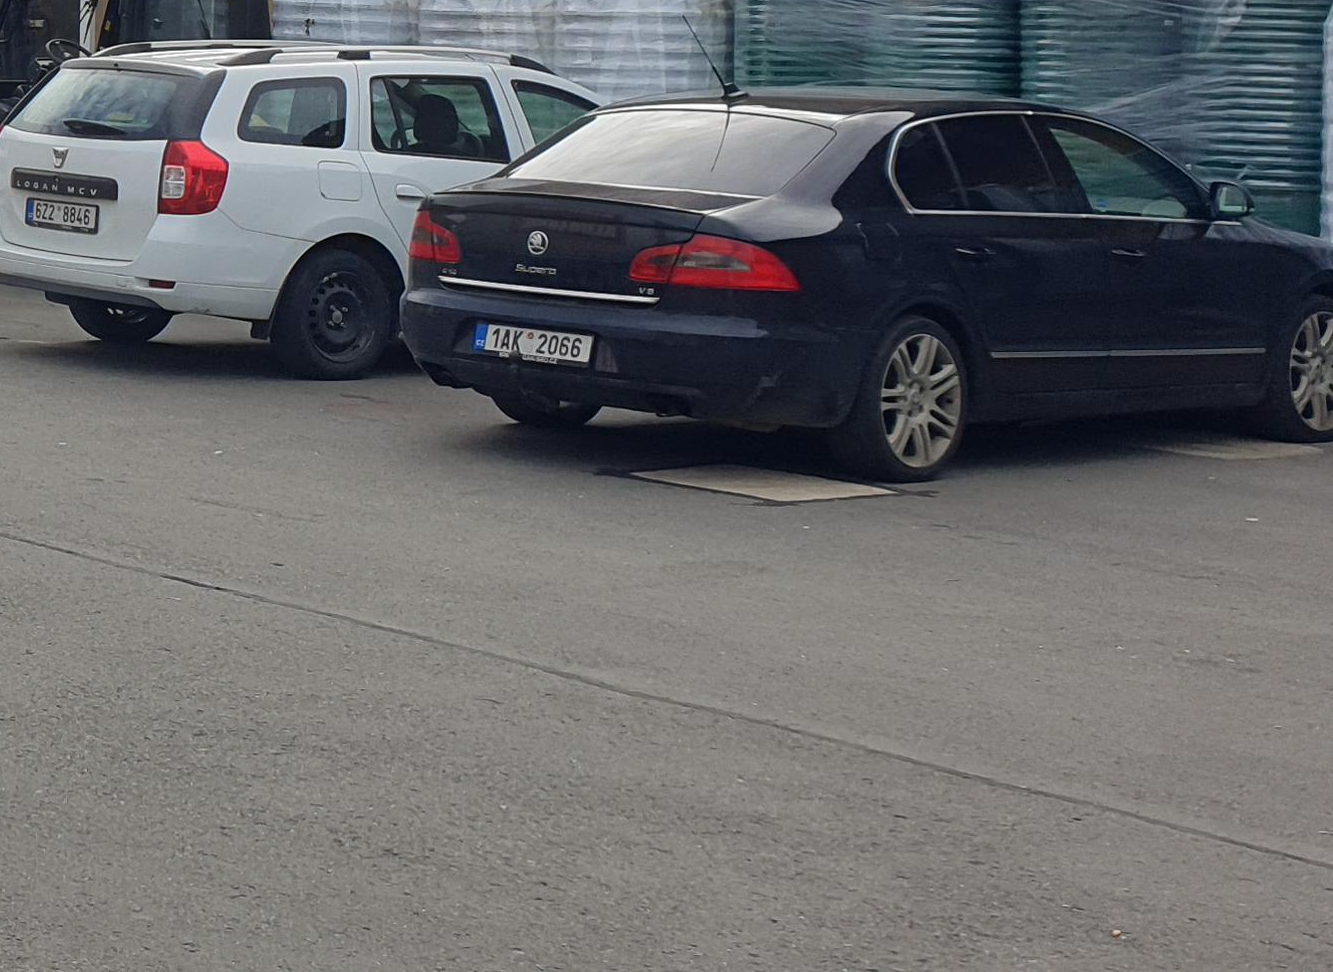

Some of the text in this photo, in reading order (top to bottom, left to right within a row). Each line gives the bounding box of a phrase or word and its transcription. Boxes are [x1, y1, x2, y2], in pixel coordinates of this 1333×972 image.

[16, 179, 59, 192] LOGAN
[63, 206, 91, 225] 8846
[491, 327, 583, 358] 1AK 2066
